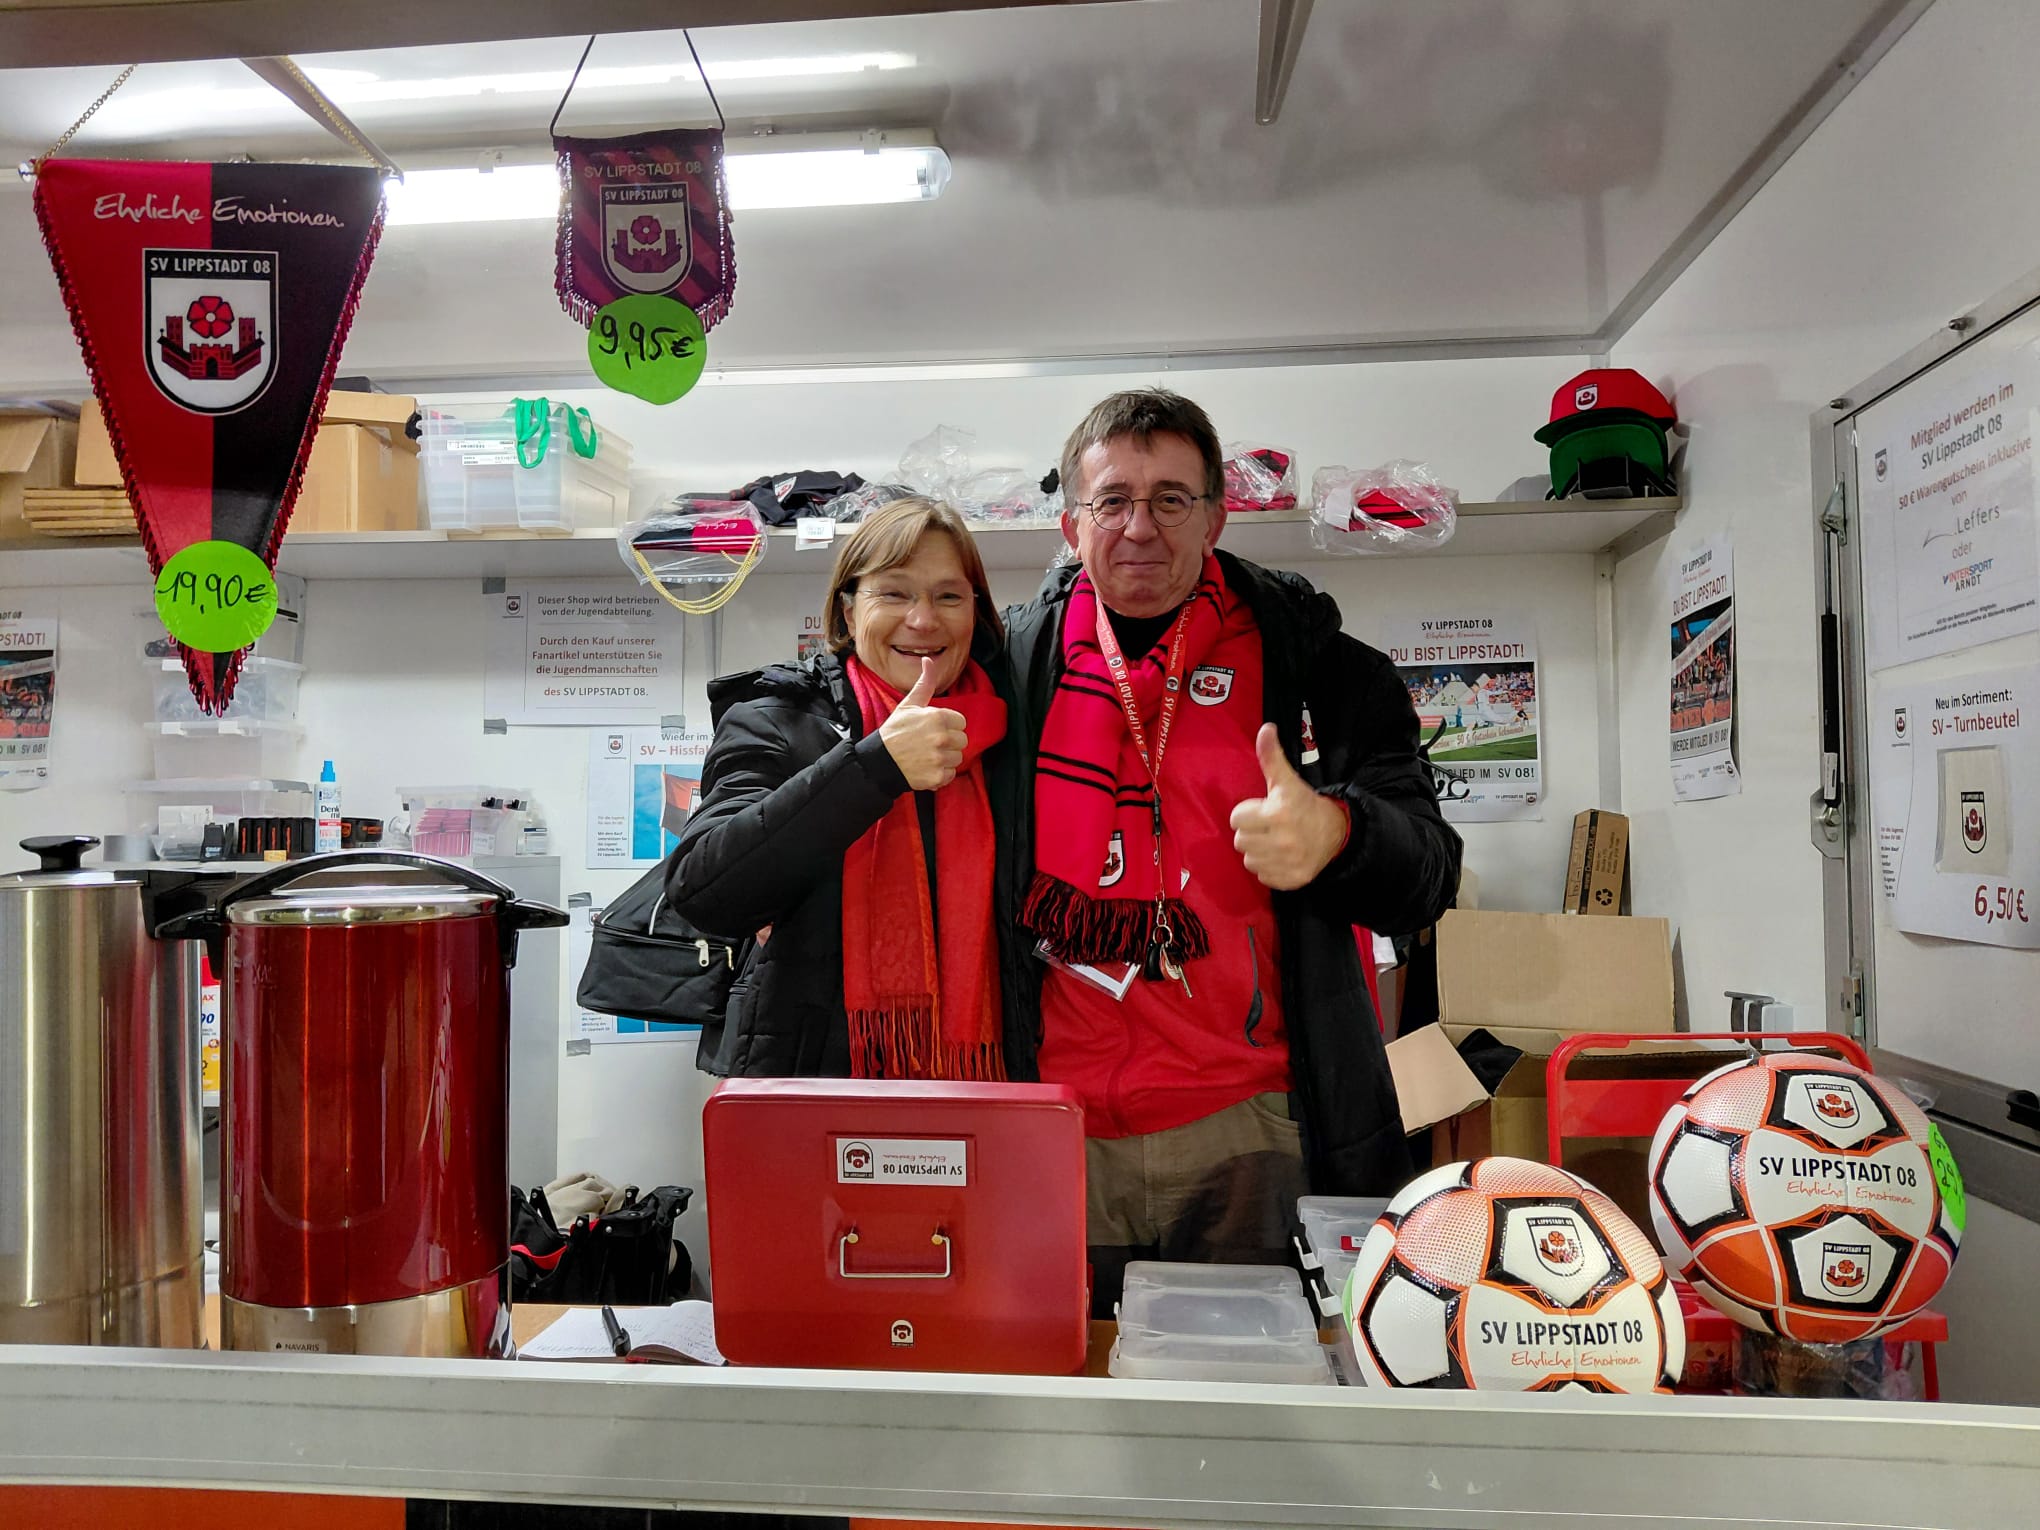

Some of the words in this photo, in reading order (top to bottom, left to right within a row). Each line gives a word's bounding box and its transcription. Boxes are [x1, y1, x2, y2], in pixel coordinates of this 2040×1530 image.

[584, 165, 602, 178] SV
[607, 161, 682, 177] LIPPSTADT
[685, 161, 702, 174] 08
[604, 191, 617, 201] SV
[620, 190, 668, 201] LIPPSTADT
[93, 192, 205, 225] Ehrliche
[150, 257, 169, 272] SV
[174, 258, 248, 273] LIPPSTADT
[253, 259, 271, 274] 08
[1910, 414, 1951, 451] Mitglied
[1953, 396, 1996, 427] werden
[1999, 383, 2014, 402] im
[1921, 450, 1934, 470] SV
[1936, 424, 1985, 462] Lippstadt
[1987, 414, 2002, 435] 08
[1916, 458, 1986, 502] Warengutschein
[1987, 436, 2032, 469] inklusive
[1951, 490, 1968, 506] von
[1952, 541, 1973, 559] oder
[1955, 574, 1981, 592] ARNDT
[537, 596, 565, 604] Dieser
[567, 596, 590, 607] Shop
[592, 595, 612, 604] wird
[613, 595, 660, 604] betrieben
[560, 607, 576, 616] der
[804, 616, 821, 629] DU
[1421, 621, 1433, 631] SV
[1435, 619, 1480, 630] LIPPSTADT
[1481, 619, 1493, 629] 08
[540, 637, 568, 646] Durch
[570, 636, 590, 645] den
[592, 636, 615, 645] Kauf
[532, 651, 580, 660] Fanartikel
[582, 651, 645, 660] unterstützen
[647, 651, 663, 660] Sie
[1390, 647, 1408, 662] DU
[1414, 646, 1444, 661] BIST
[1448, 643, 1524, 660] LIPPSTADT!
[536, 665, 551, 674] die
[553, 665, 658, 676] Jugendmannschaften
[544, 687, 561, 696] des
[563, 688, 576, 696] SV
[578, 687, 631, 696] LIPPSTADT
[633, 688, 649, 696] 08.
[1118, 681, 1141, 730] LIPPSTADT
[1164, 697, 1175, 711] SV
[1935, 696, 1950, 710] Neu
[1951, 695, 1961, 708] im
[1962, 688, 2013, 706] Sortiment:
[1931, 719, 1944, 736] SV
[1953, 708, 2020, 733] Turnbeutel
[661, 733, 694, 741] Wieder
[696, 732, 708, 741] im
[640, 745, 656, 756] SV
[1480, 768, 1491, 779] IM
[1498, 768, 1511, 778] SV
[1515, 767, 1535, 778] 08!
[882, 1163, 895, 1174] 08
[898, 1164, 946, 1175] LIPPSTADT
[949, 1165, 963, 1175] SV
[1759, 1156, 1784, 1175] SV
[1792, 1157, 1891, 1184] LIPPSTADT
[1896, 1166, 1917, 1187] 08
[1480, 1320, 1508, 1344] SV
[1516, 1321, 1618, 1346] LIPPSTADT
[1623, 1319, 1643, 1343] 08
[284, 1343, 320, 1352] NAVARIS
[1511, 1350, 1573, 1369] Ehrliche
